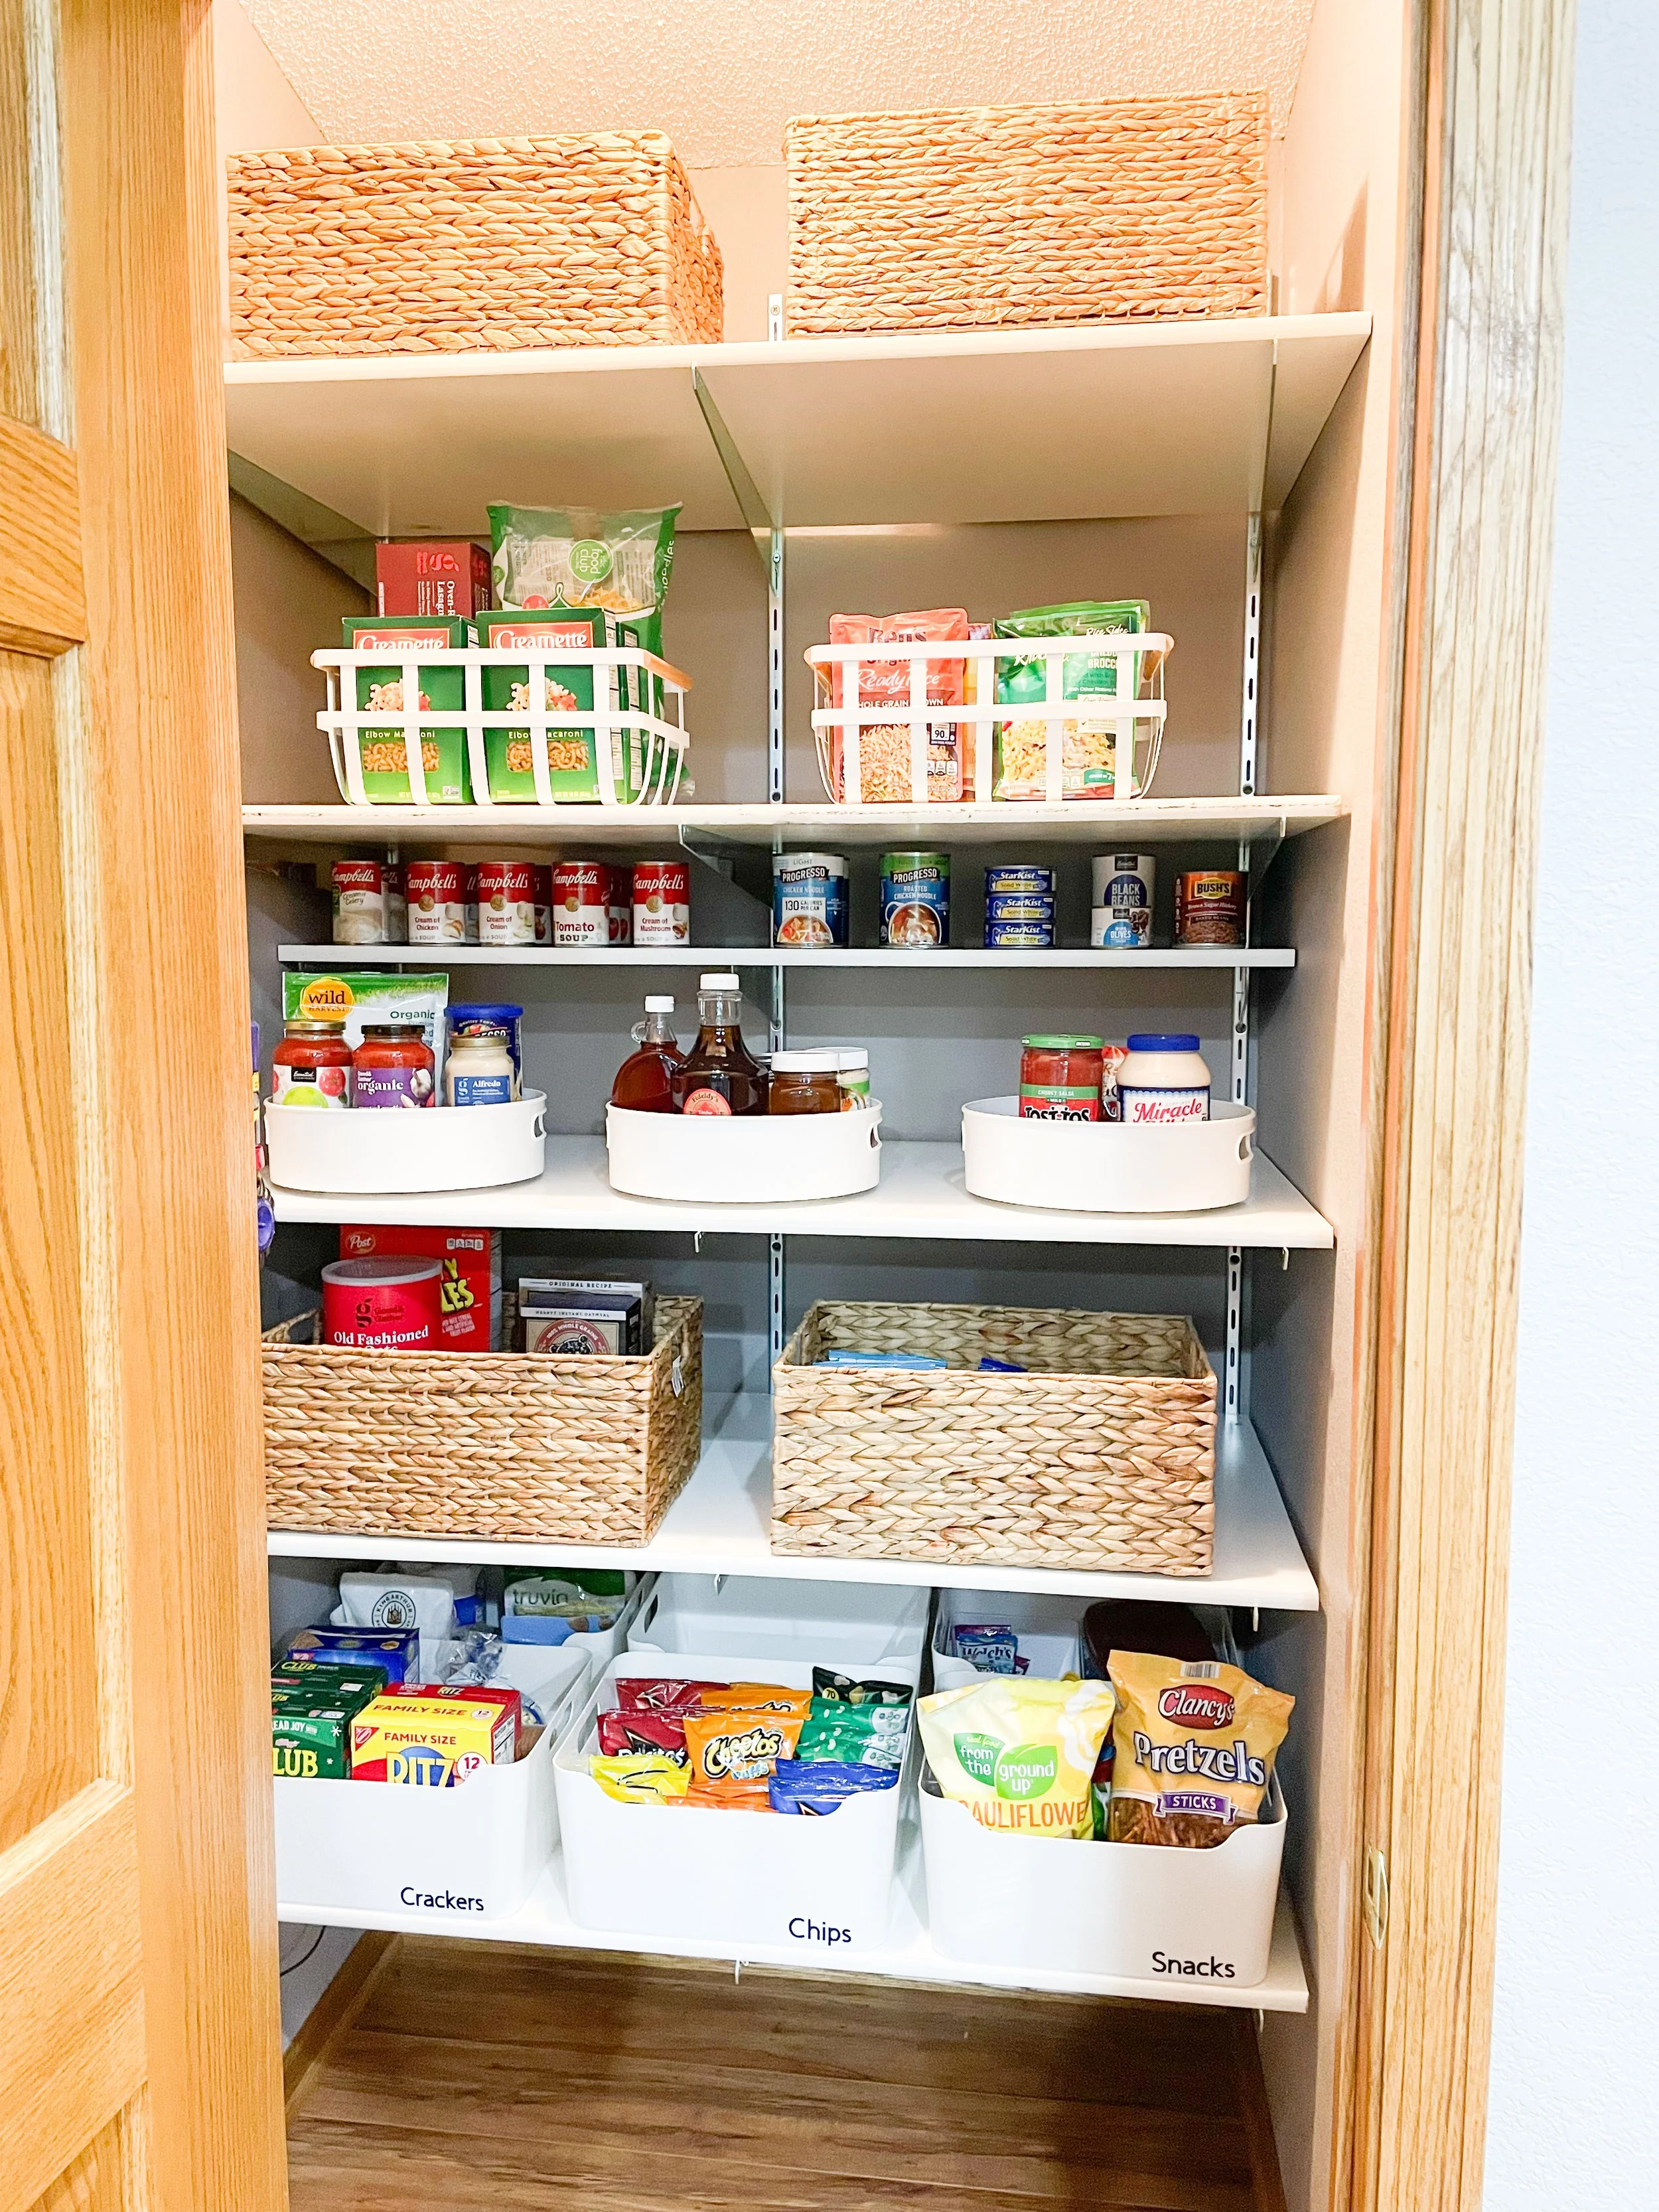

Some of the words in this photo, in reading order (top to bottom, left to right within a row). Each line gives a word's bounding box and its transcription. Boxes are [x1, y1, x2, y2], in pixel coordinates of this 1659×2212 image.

[579, 548, 592, 573] club
[590, 548, 603, 574] food
[435, 581, 445, 616] Lasagn
[447, 580, 455, 616] Oven-R
[1088, 658, 1116, 669] BROCC
[858, 668, 907, 695] Ready
[881, 699, 910, 707] GRAIN
[394, 730, 435, 739] Maoni
[508, 731, 531, 739] Elbo
[546, 729, 583, 738] acaroni
[934, 729, 945, 739] 90
[332, 867, 374, 885] Campbell's
[407, 873, 457, 893] Campbell's
[478, 872, 528, 891] Campbell's
[553, 869, 598, 886] Campbell's
[633, 873, 684, 893] Campbell's
[782, 867, 826, 883] PROGRESSO
[893, 868, 937, 883] PROGRESSO
[1000, 871, 1035, 879] StarKist
[1112, 883, 1140, 895] BLACK
[1196, 883, 1230, 894] BUSH'S
[785, 900, 800, 911] 130
[1005, 898, 1042, 907] StarKist
[1112, 895, 1140, 906] BEANS
[556, 921, 595, 932] Tomato
[308, 990, 346, 1004] wild
[390, 1009, 435, 1020] Organic
[358, 1078, 404, 1095] organic
[1133, 1098, 1202, 1122] Miracle
[350, 1235, 372, 1250] Post
[334, 1331, 354, 1345] Old
[357, 1325, 429, 1345] Fashioned
[557, 1323, 579, 1332] WHOLE
[579, 1324, 599, 1341] GRAINS
[391, 1594, 413, 1613] ARTHUR
[281, 1661, 318, 1670] CLUB
[437, 1686, 465, 1696] RITZ
[826, 1690, 835, 1699] 70
[373, 1704, 431, 1713] FAMILY
[431, 1708, 468, 1716] SIZE
[1159, 1690, 1235, 1726] Clancy's
[272, 1720, 290, 1732] EAD
[291, 1722, 305, 1732] JOY
[384, 1732, 427, 1743] FAMILY
[430, 1735, 457, 1745] SIZE
[705, 1727, 782, 1777] Cheetos
[960, 1745, 993, 1760] from
[1133, 1731, 1265, 1786] Pretzels
[272, 1747, 319, 1777] LUB
[386, 1752, 455, 1787] RITZ
[464, 1757, 480, 1770] 12
[965, 1759, 992, 1776] the
[998, 1760, 1054, 1781] ground
[1011, 1779, 1031, 1795] up
[1173, 1795, 1216, 1810] STICKS
[958, 1800, 1086, 1828] AULIFLOWE
[401, 1887, 484, 1911] Crackers
[789, 1918, 851, 1946] Chips
[1152, 1951, 1236, 1978] Snacks
